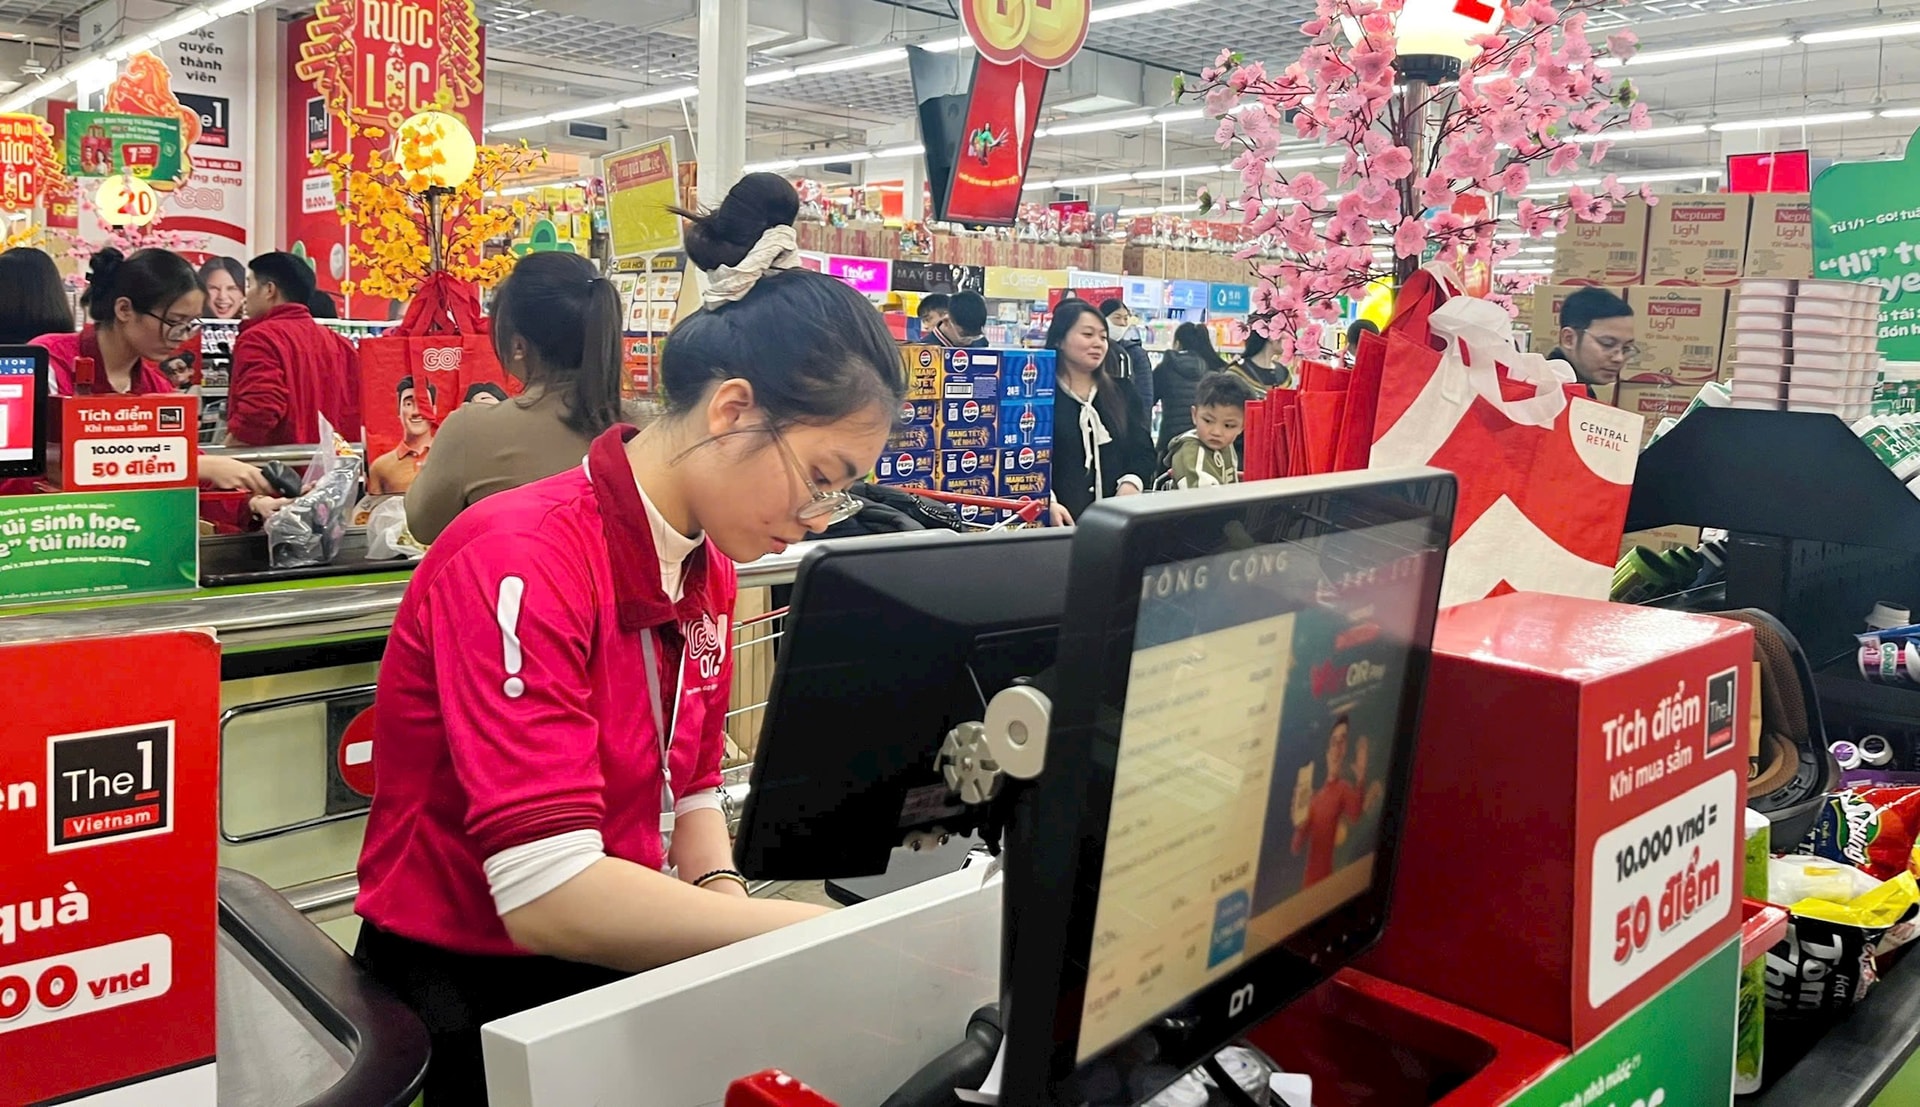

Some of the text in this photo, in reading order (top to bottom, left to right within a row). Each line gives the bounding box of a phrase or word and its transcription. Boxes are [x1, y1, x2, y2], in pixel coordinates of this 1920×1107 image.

[180, 56, 222, 71] thành
[185, 70, 217, 84] viên
[1674, 209, 1722, 221] Neptune
[1650, 304, 1697, 316] Neptune
[78, 405, 153, 421] Tích điểm
[84, 423, 102, 433] Khi
[127, 421, 148, 432] sắm
[1580, 421, 1629, 443] CENTRAL
[91, 445, 134, 455] 10.000
[137, 444, 160, 453] vnd
[1586, 434, 1621, 452] RETAIL
[92, 455, 176, 477] 50 điểm
[0, 512, 141, 536] úi sinh học,
[26, 533, 62, 552] túi
[66, 532, 127, 549] nilon
[1602, 680, 1702, 762] Tích điểm
[1609, 739, 1693, 802] Khi mua sắm
[72, 807, 152, 836] Vietnam
[1615, 824, 1673, 883] 10.000
[1676, 804, 1706, 848] vnd
[1613, 844, 1721, 966] 50 điểm
[87, 963, 151, 1001] vnd
